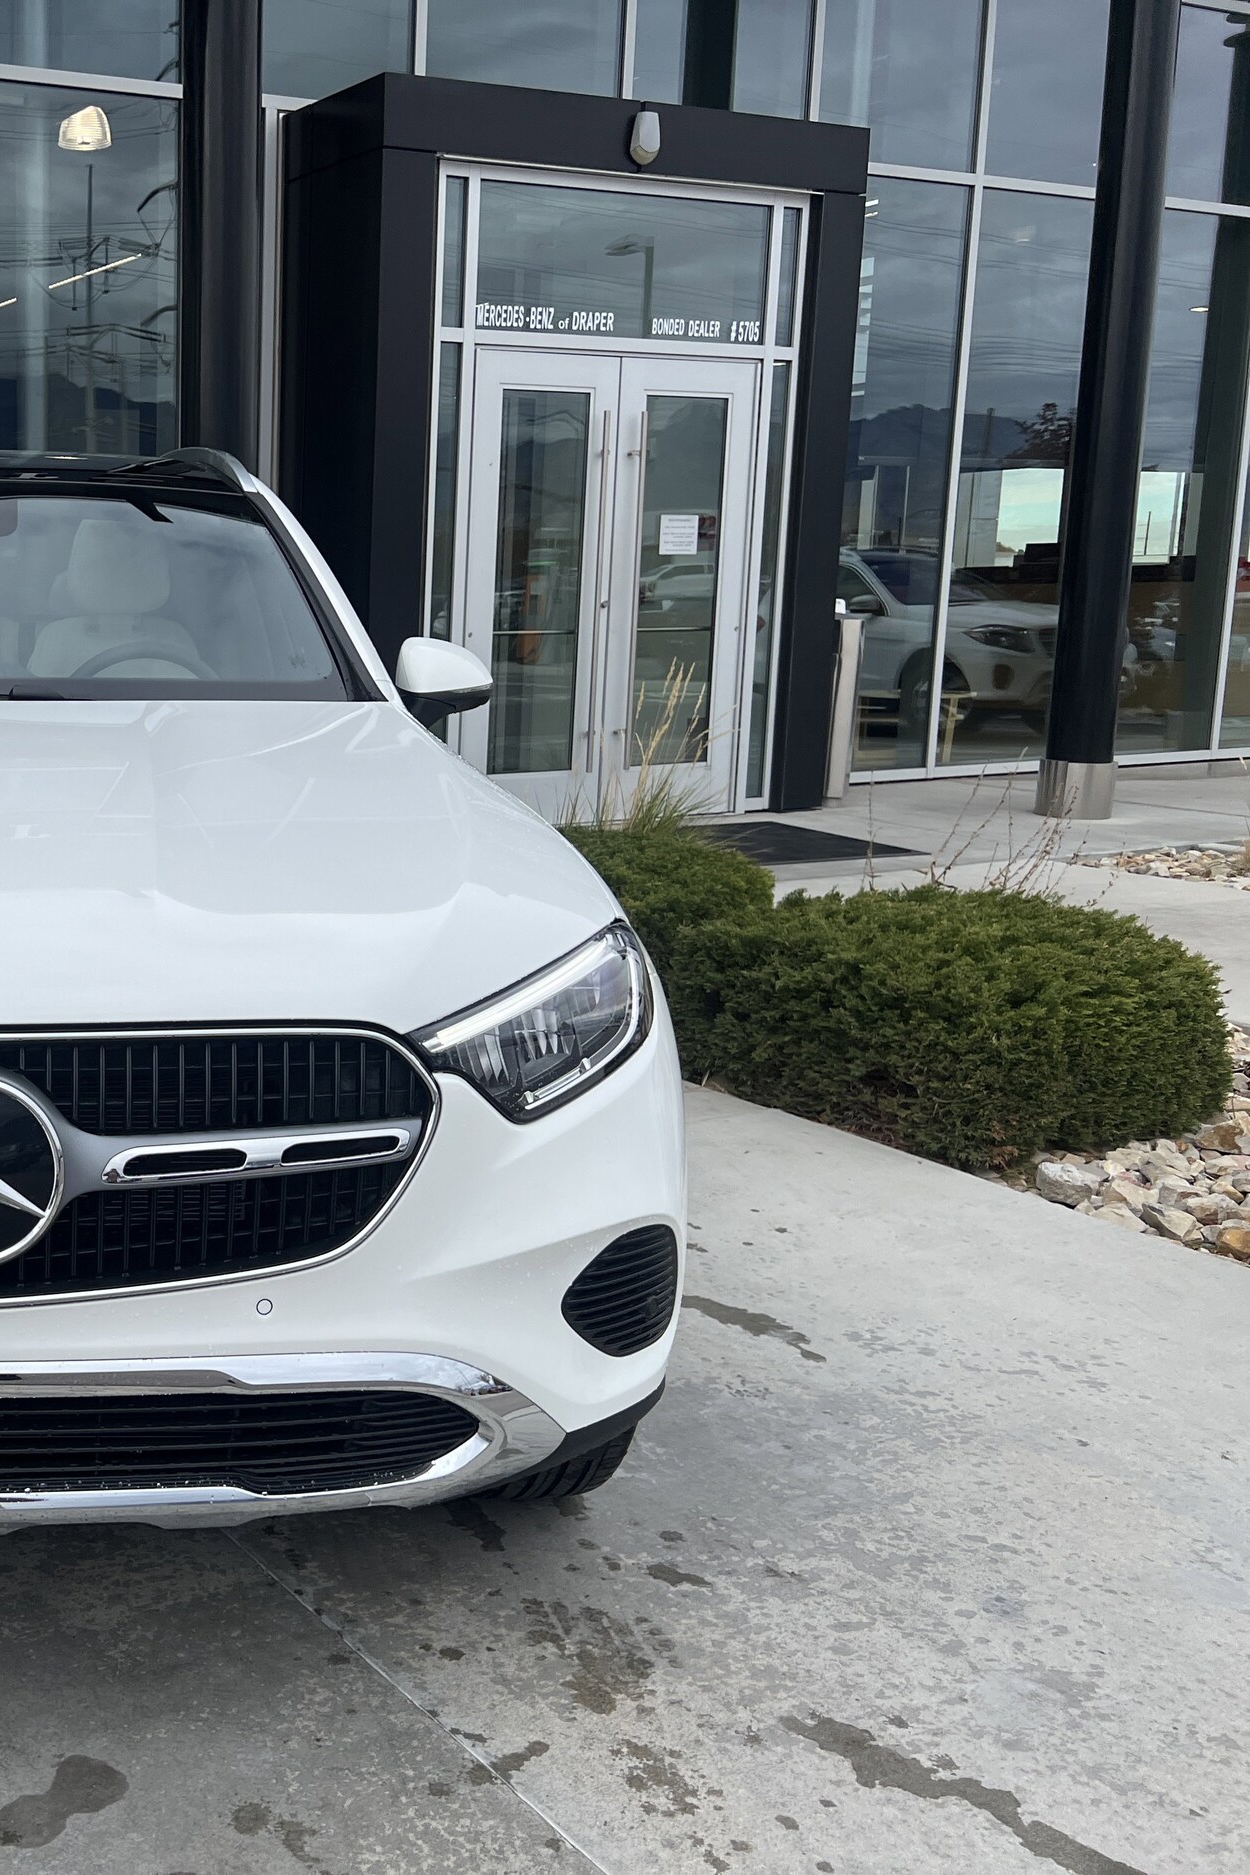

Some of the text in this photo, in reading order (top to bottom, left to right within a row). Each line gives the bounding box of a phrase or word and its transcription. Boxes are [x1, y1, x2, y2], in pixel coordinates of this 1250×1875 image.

[558, 318, 569, 330] of
[572, 311, 614, 331] DRAPER
[652, 318, 685, 336] BONDED
[688, 320, 721, 338] DEALER
